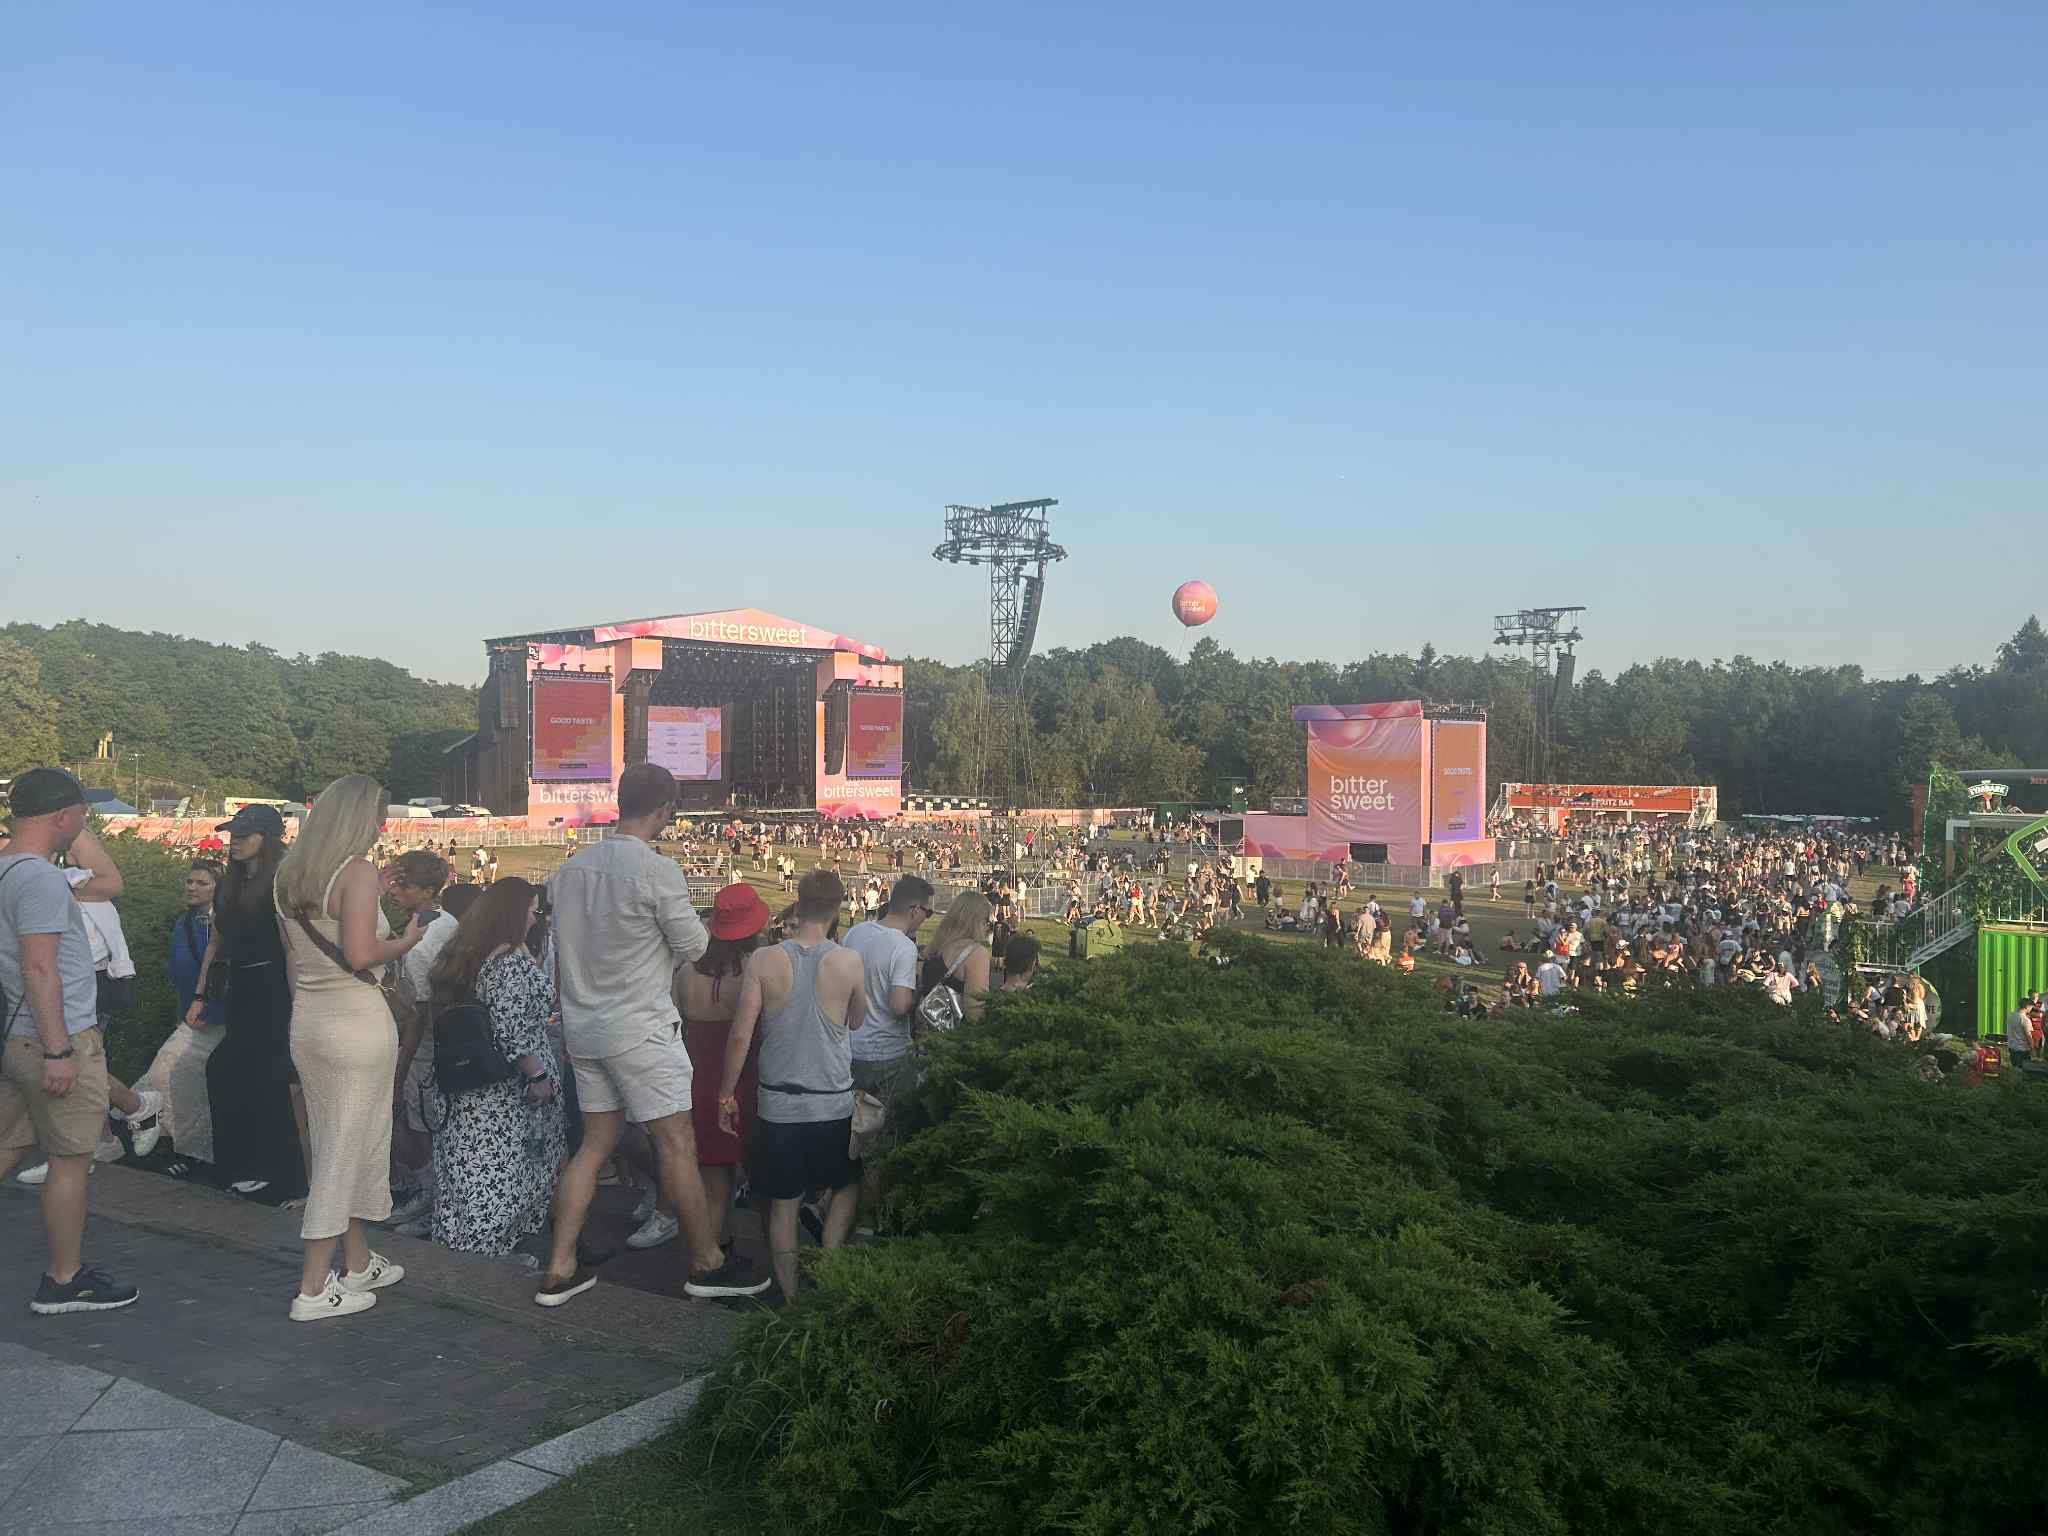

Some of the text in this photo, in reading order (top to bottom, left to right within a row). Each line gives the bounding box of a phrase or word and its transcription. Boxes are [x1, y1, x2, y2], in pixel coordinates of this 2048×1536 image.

[690, 617, 807, 644] bittersweet
[823, 784, 896, 798] bittersweet
[1330, 775, 1389, 794] bitter
[1330, 792, 1395, 811] sweet
